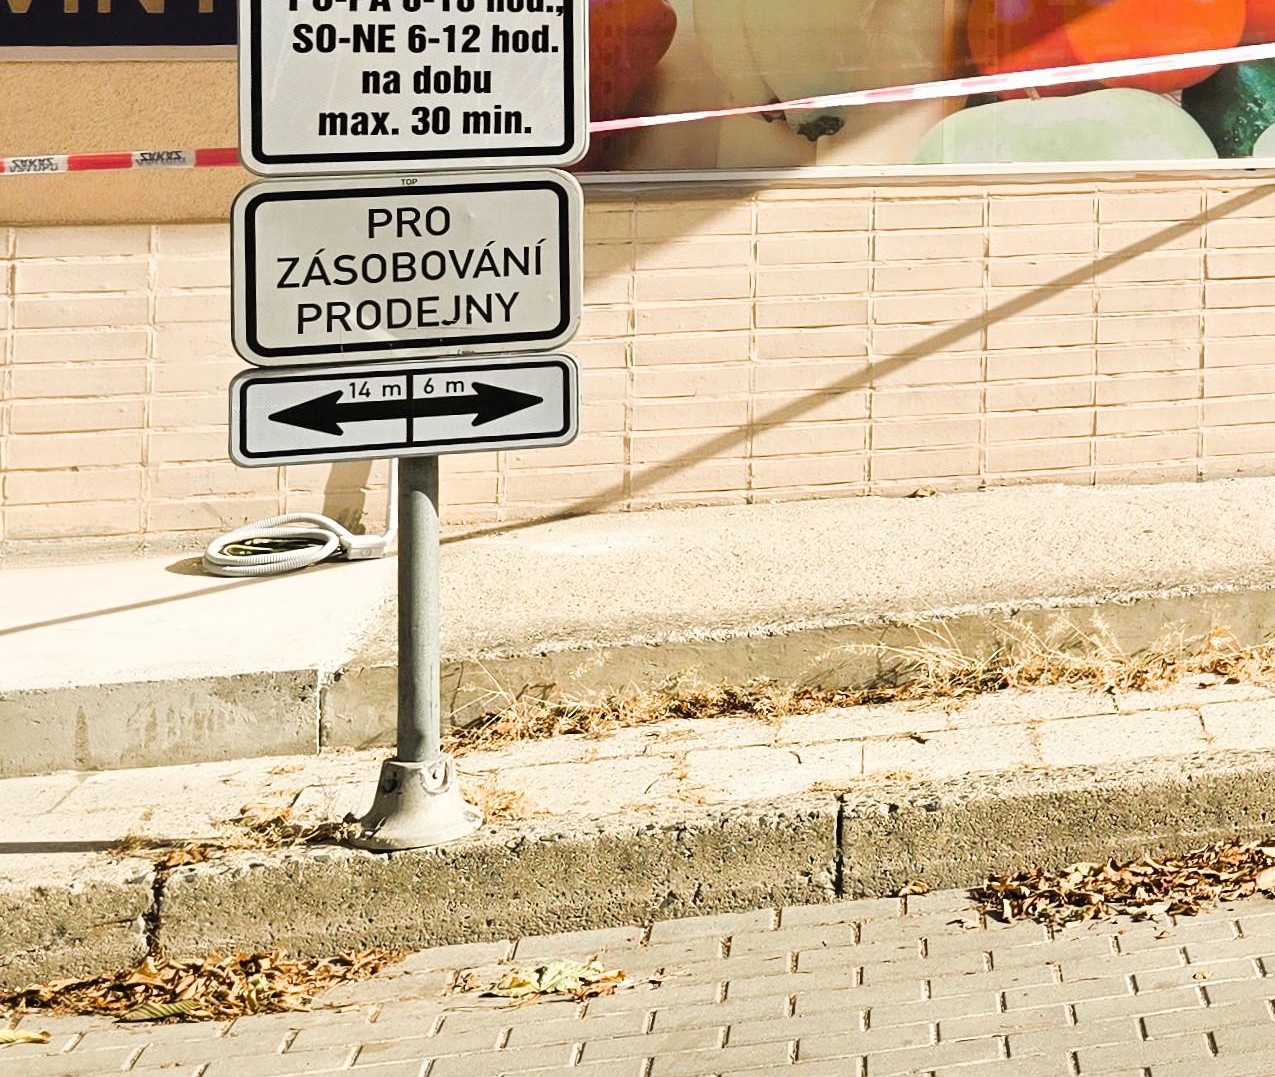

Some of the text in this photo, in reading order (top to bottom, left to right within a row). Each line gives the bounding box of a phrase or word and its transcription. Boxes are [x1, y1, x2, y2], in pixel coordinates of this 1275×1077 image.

[292, 24, 559, 53] SO-NE 6-12 hod.
[362, 65, 492, 94] na dobu
[318, 105, 532, 136] max. 30 min.
[368, 206, 451, 238] PRO
[276, 238, 547, 289] ZÁSOBOVÁNÍ
[297, 292, 520, 335] PRODEJNY
[349, 381, 401, 399] 14 m
[424, 377, 464, 394] 6 m
